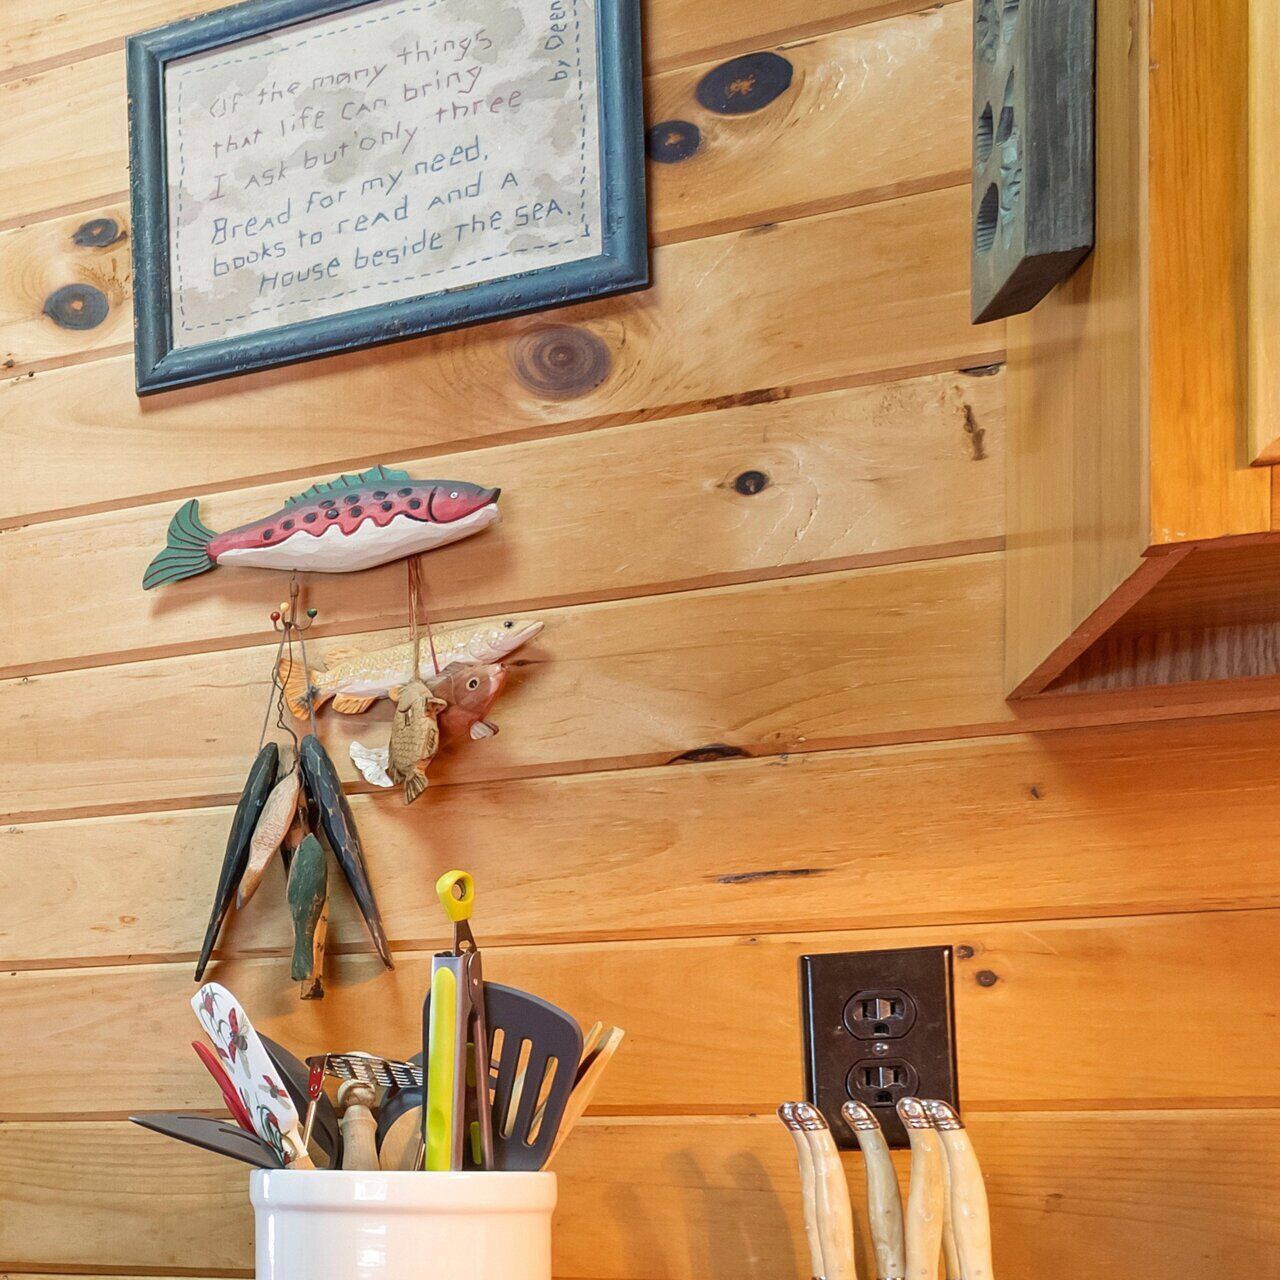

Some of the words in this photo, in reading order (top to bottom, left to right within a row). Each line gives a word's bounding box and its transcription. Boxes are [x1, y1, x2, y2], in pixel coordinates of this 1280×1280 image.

[210, 93, 243, 118] Of
[258, 81, 301, 105] the
[312, 64, 387, 88] many
[396, 29, 492, 64] things
[548, 60, 571, 82] by
[281, 106, 325, 136] life
[404, 66, 482, 101] bring
[210, 173, 227, 200] I
[303, 142, 348, 170] but
[359, 121, 418, 154] only
[434, 90, 522, 123] three
[361, 170, 403, 196] my
[213, 241, 286, 277] books
[298, 229, 323, 248] to
[354, 228, 443, 270] beside
